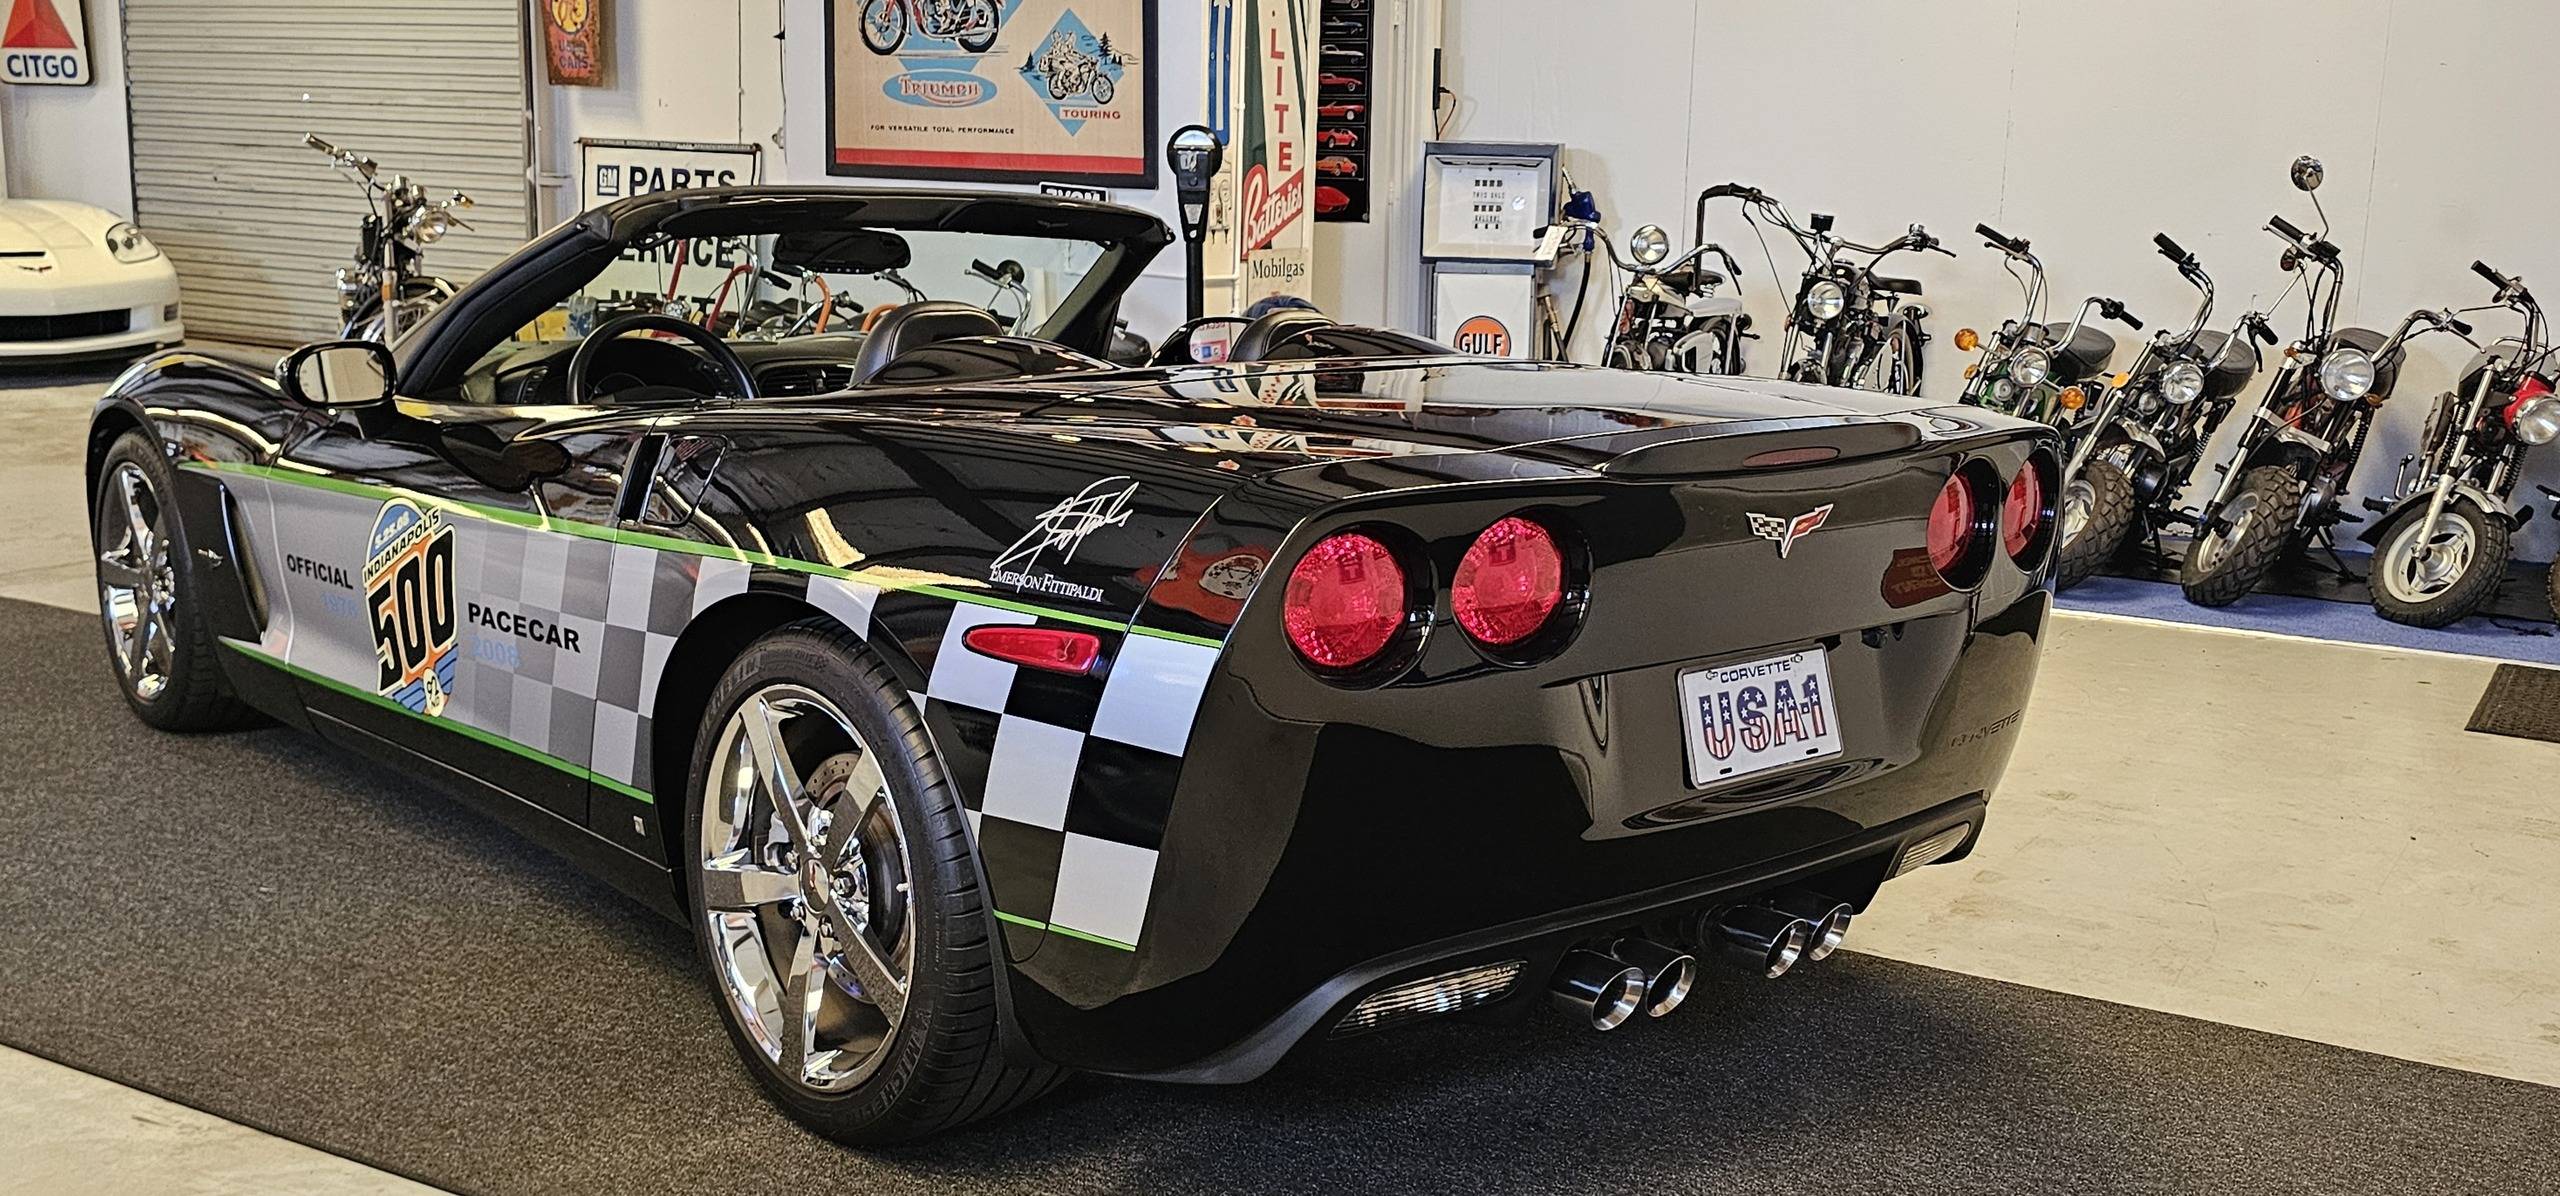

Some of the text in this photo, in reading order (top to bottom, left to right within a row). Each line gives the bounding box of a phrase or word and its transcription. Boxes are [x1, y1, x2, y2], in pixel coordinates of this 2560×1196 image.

[7, 54, 78, 79] CITGO
[899, 75, 981, 98] TRIUMPH
[1062, 108, 1121, 120] TOURING
[957, 127, 1015, 135] PERFORMANCE
[599, 167, 617, 188] GM
[1252, 257, 1305, 283] Mobilgas
[1459, 332, 1503, 355] GULF
[363, 508, 440, 583] INDIANAPOLIS
[286, 553, 354, 590] OFFICIAL
[989, 568, 1104, 602] EMERSON FITTIPALDI
[367, 528, 456, 692] 500
[468, 602, 581, 654] PACECAR
[1720, 660, 1791, 684] CORVETTE
